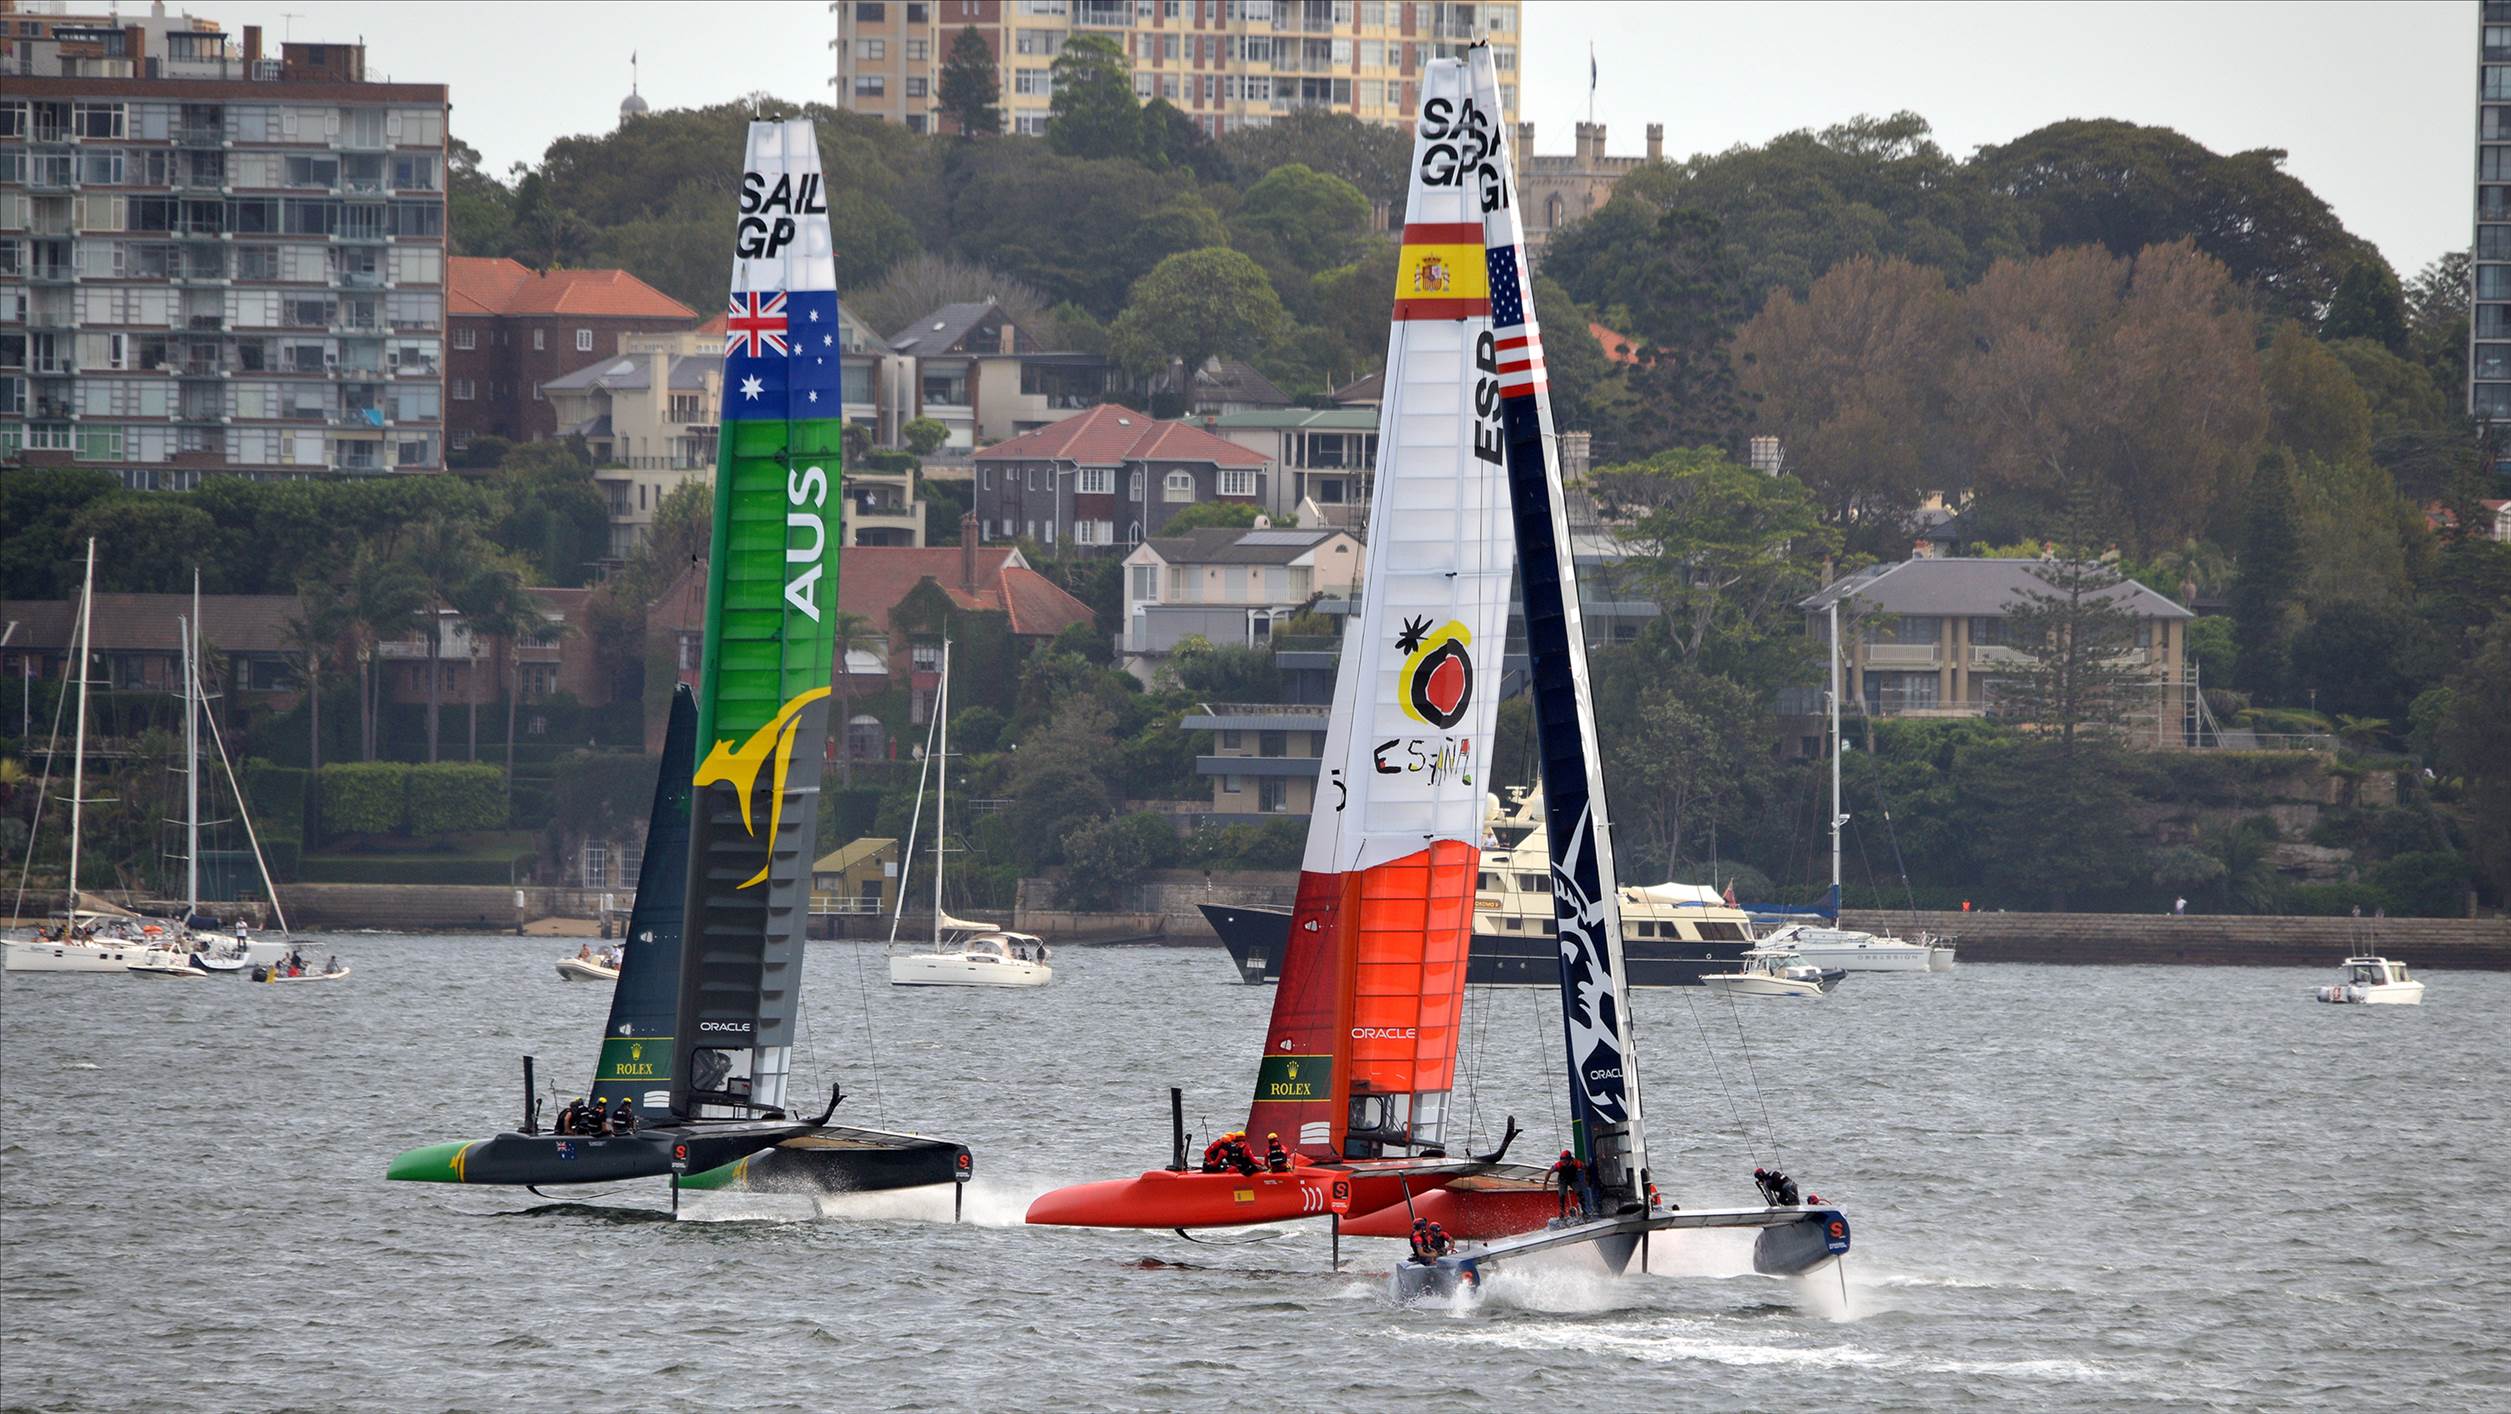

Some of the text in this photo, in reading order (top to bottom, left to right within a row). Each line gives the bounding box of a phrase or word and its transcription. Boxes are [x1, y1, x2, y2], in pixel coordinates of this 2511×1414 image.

[1420, 98, 1475, 140] SA
[740, 171, 827, 215] SAIL
[736, 216, 796, 259] GP
[784, 466, 828, 624] AUS
[700, 1022, 750, 1032] ORACLE
[1351, 1028, 1416, 1039] ORACLE
[616, 1063, 653, 1075] ROLEX
[1590, 1067, 1624, 1081] ORACL
[1271, 1083, 1311, 1095] ROLEX
